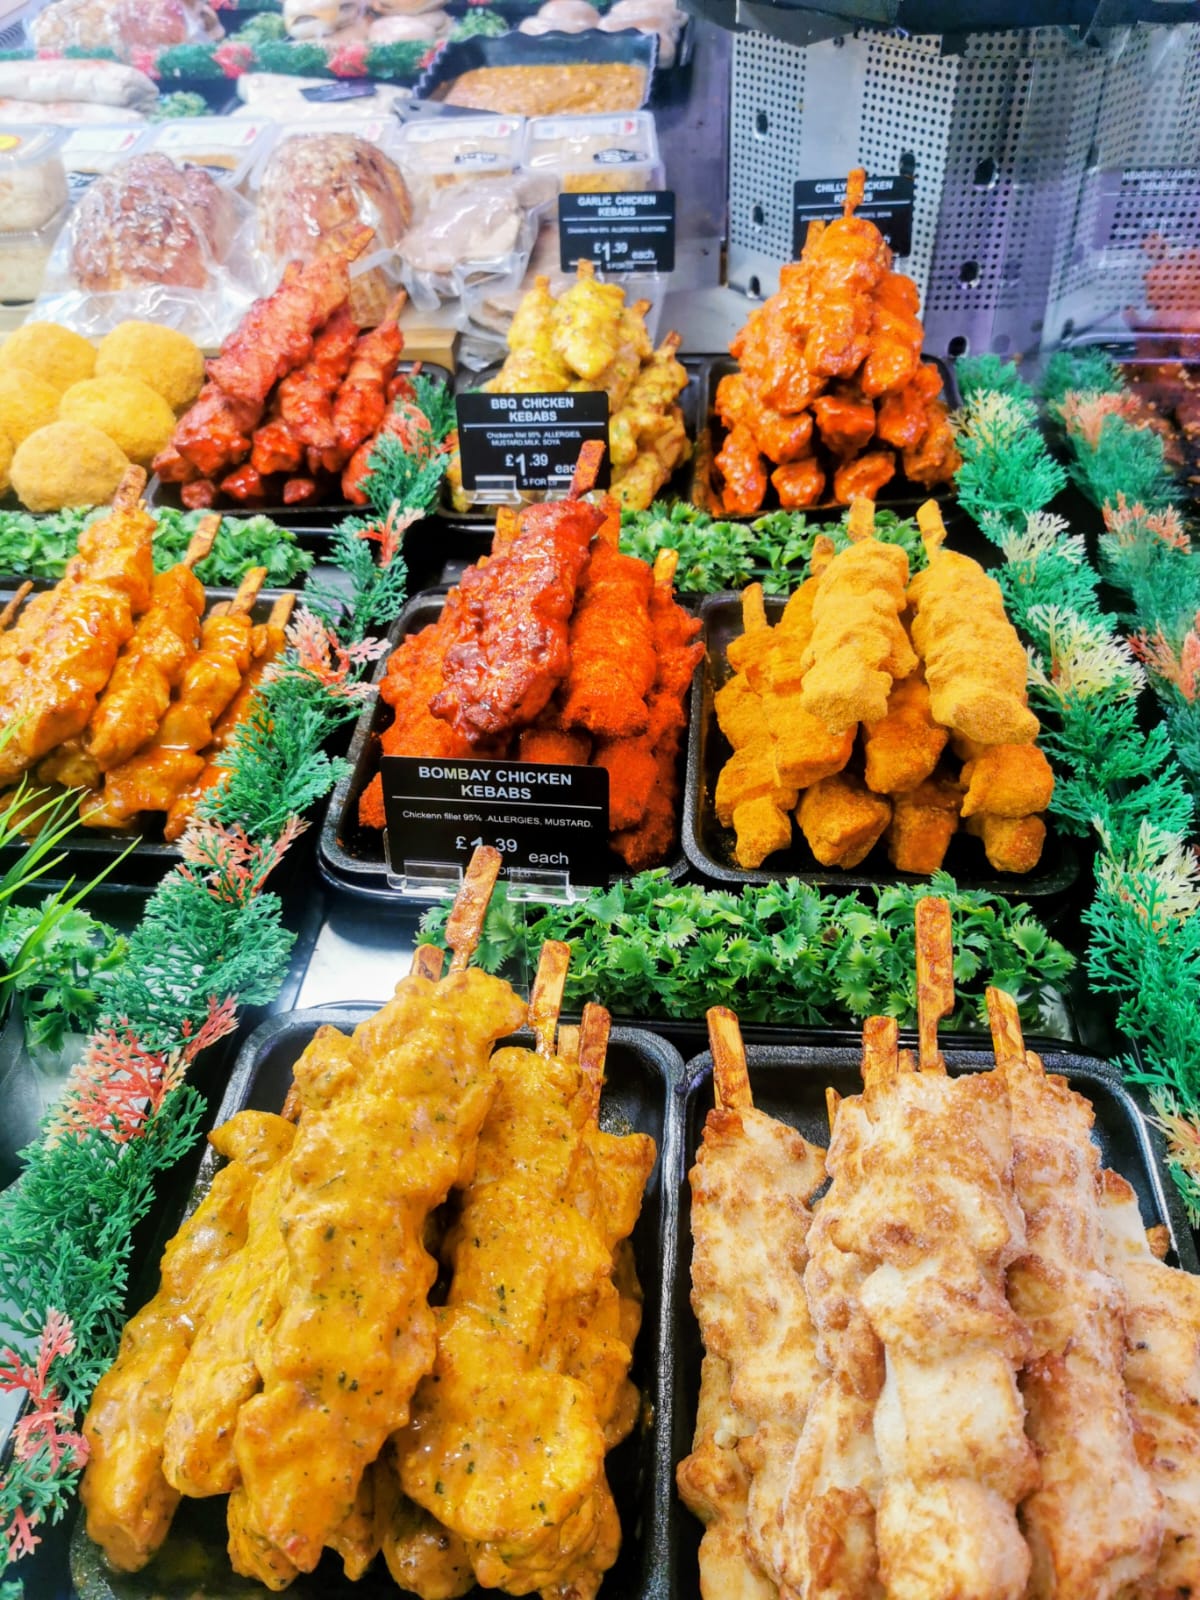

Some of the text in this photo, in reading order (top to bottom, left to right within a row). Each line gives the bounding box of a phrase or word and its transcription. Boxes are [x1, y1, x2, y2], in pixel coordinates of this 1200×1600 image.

[815, 180, 893, 194] CHILLY ICKEN
[577, 195, 657, 206] GARLIC CHICKEN
[598, 206, 636, 216] KEBABS
[593, 241, 655, 261] £1.39 each
[490, 397, 574, 410] BBQ CHICKEN
[509, 411, 557, 422] KEBABS
[505, 453, 577, 476] £1.39 eac
[418, 766, 572, 785] BOMBAY CHICKEN
[461, 785, 532, 799] KEBABS
[463, 813, 482, 821] 95%
[455, 835, 569, 865] £39 each
